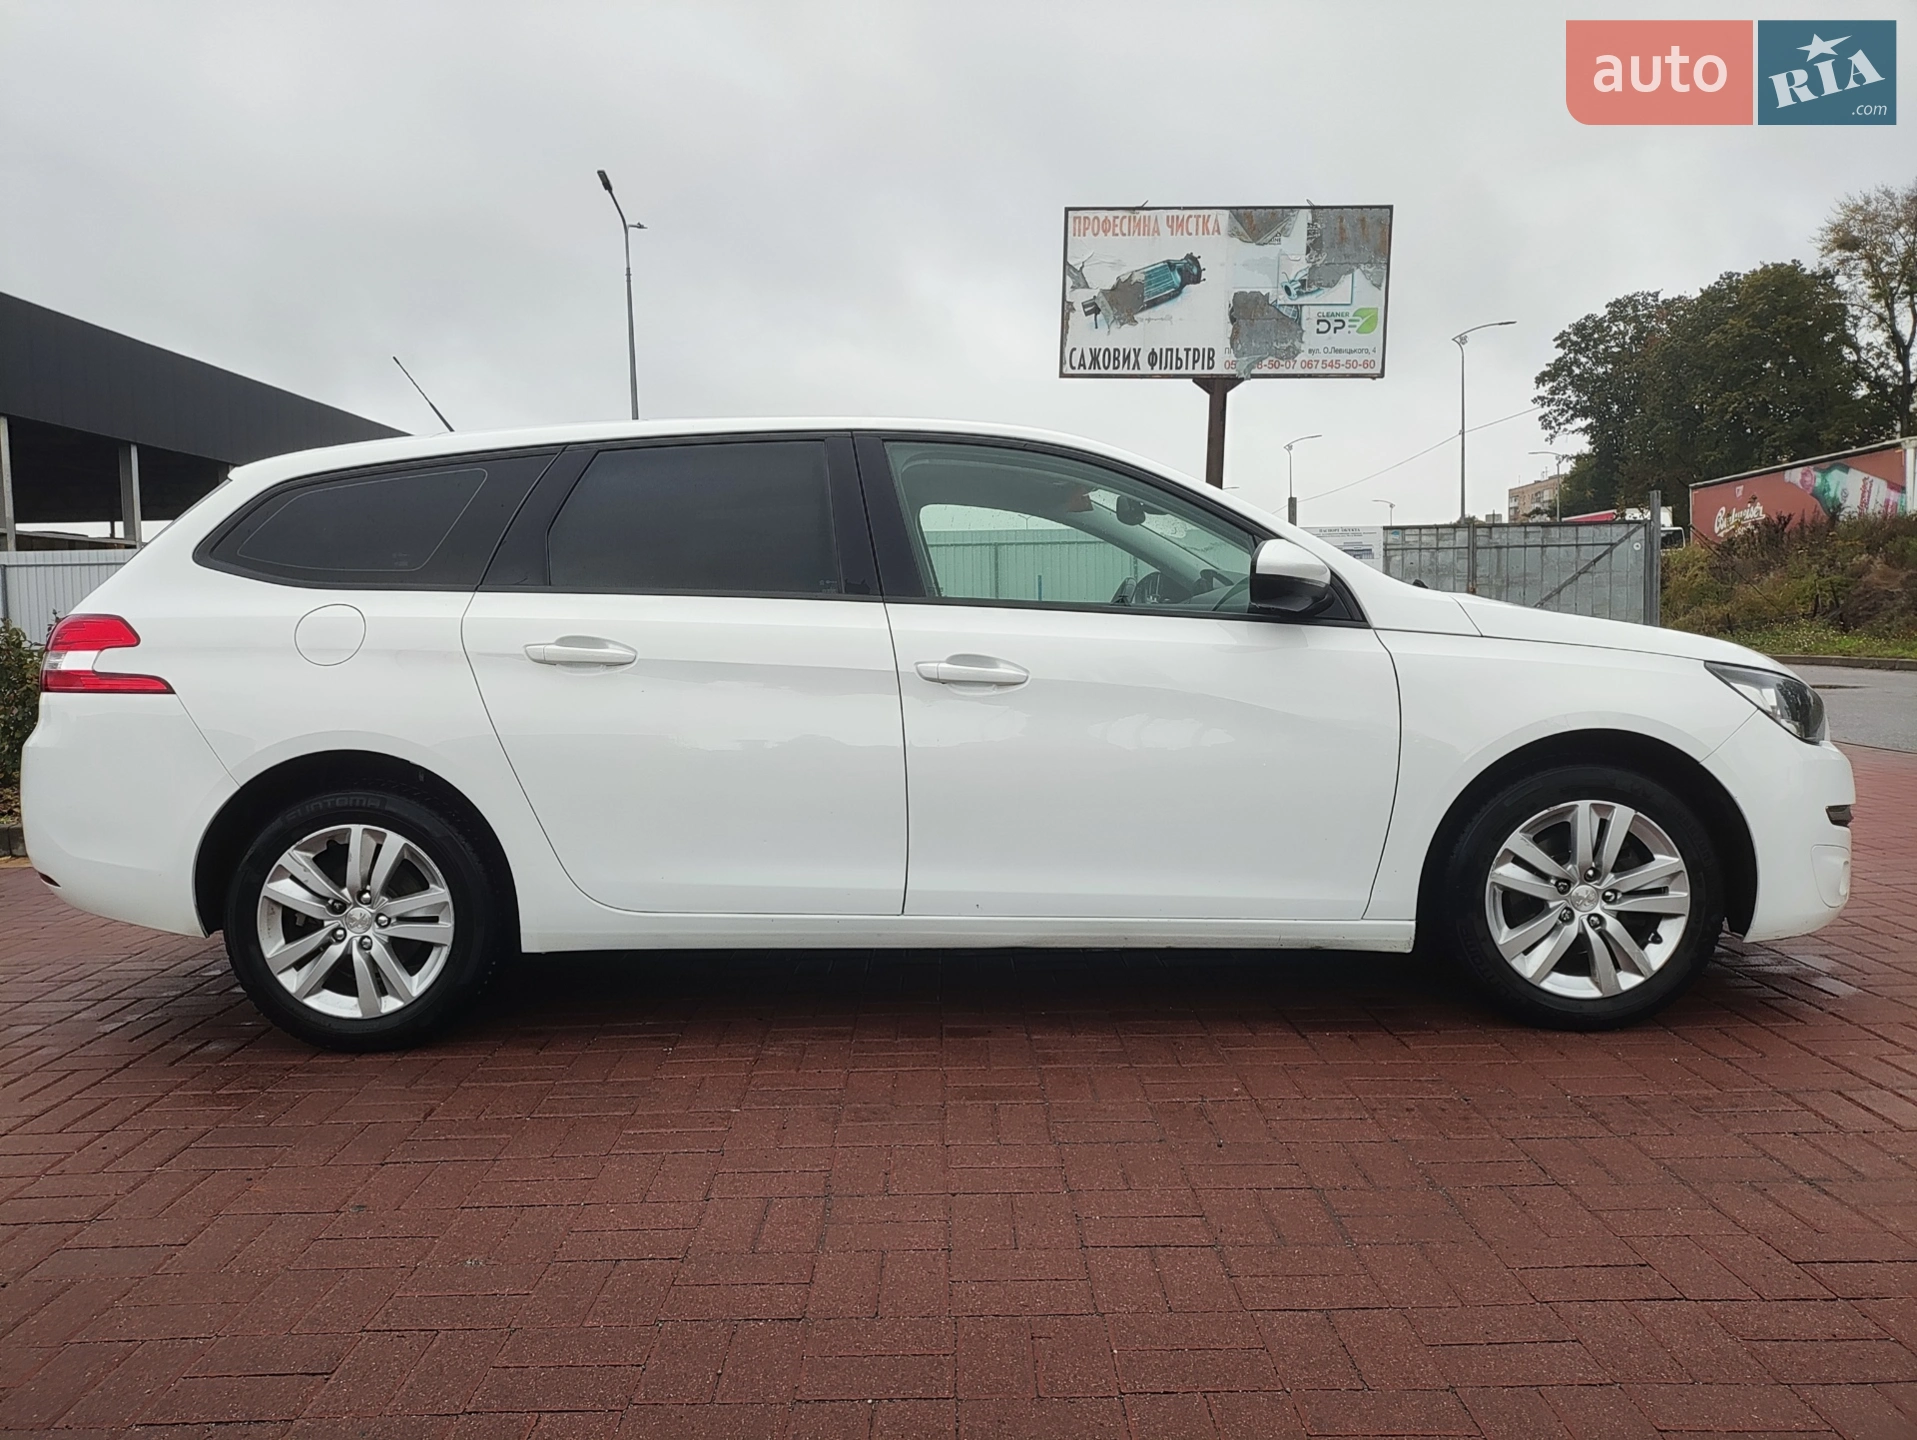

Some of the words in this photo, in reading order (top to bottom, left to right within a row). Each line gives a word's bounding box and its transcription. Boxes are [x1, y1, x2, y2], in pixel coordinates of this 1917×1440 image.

[1072, 213, 1161, 237] ПРОФЕСІЙНА
[1165, 213, 1222, 236] ЧИСТКА
[1068, 347, 1142, 371] САЖОВИХ
[1147, 347, 1216, 370] ФІЛЬТРІВ
[1223, 359, 1238, 370] 05
[1300, 359, 1320, 370] 067
[1320, 359, 1376, 370] 545-50-60
